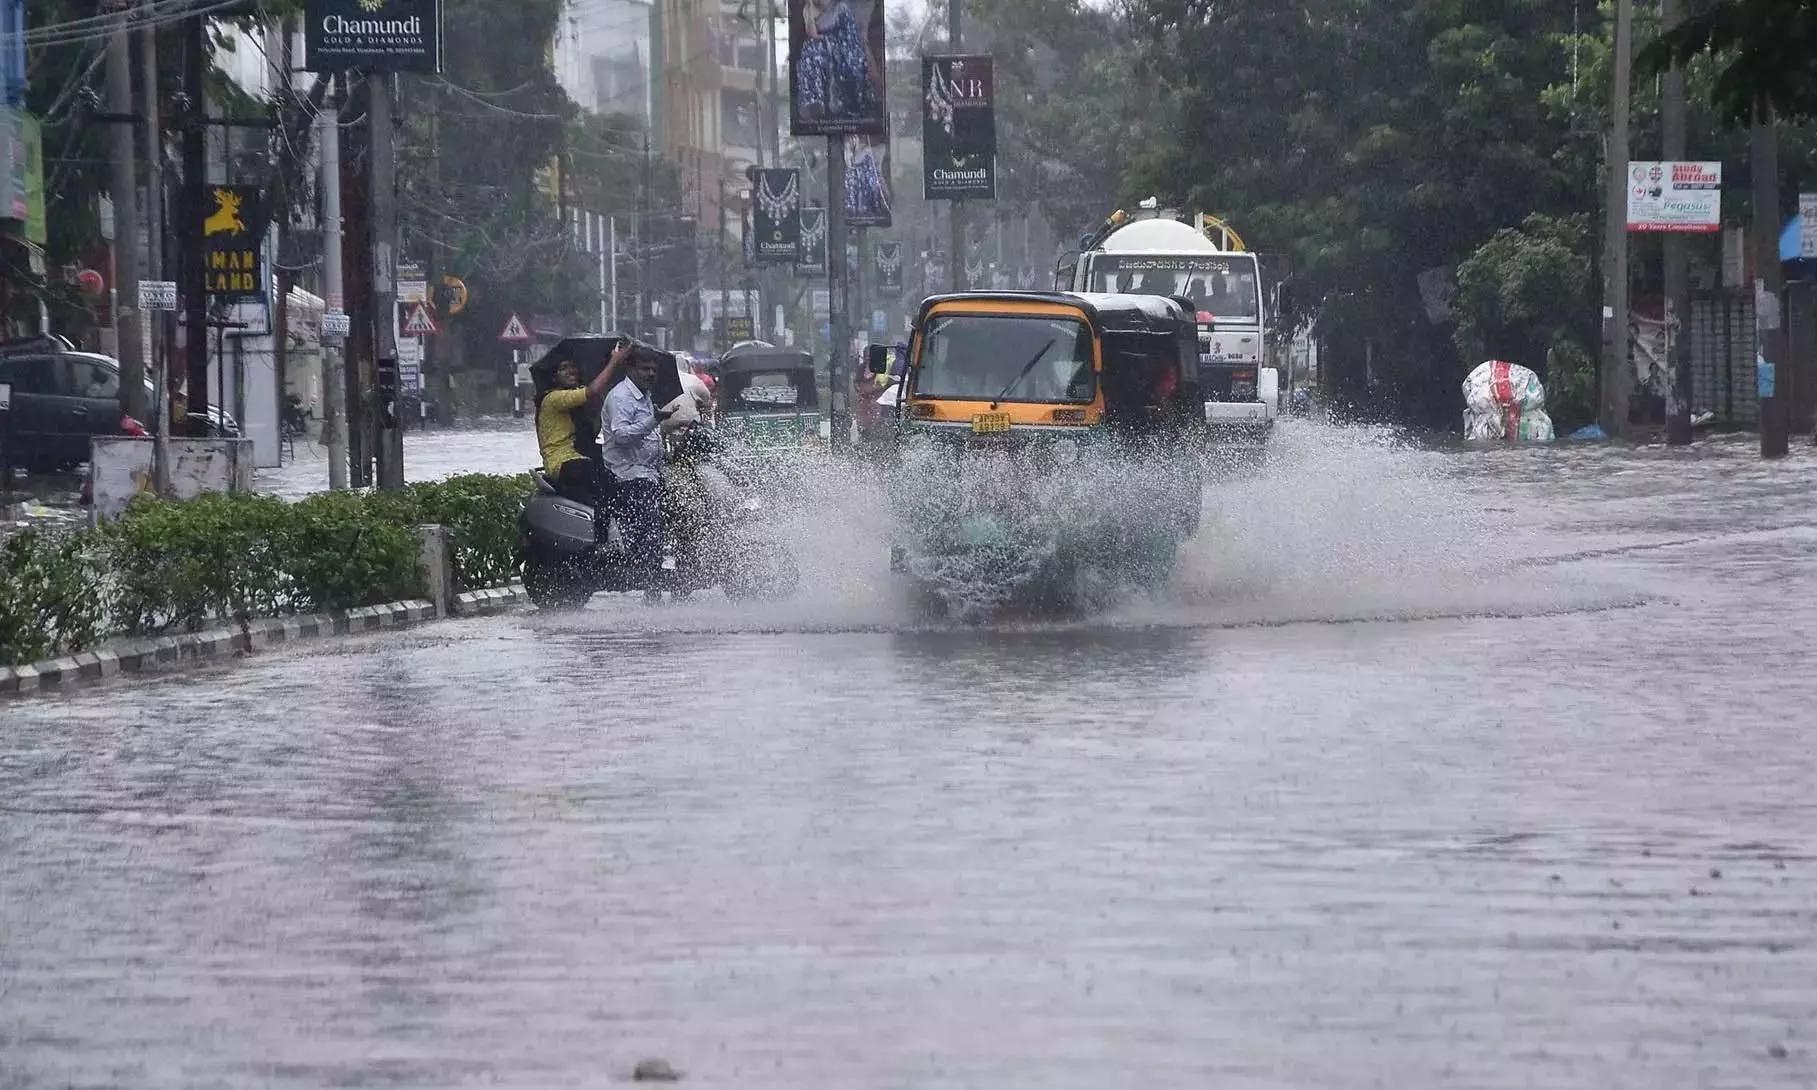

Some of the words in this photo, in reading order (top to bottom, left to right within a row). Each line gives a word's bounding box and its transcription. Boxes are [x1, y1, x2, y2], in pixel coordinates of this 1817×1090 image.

[322, 15, 421, 35] Chamundi
[323, 36, 351, 44] GOLD
[356, 36, 363, 44] &
[367, 36, 423, 44] DIAMONDS
[1672, 164, 1703, 173] Study
[933, 168, 987, 180] Chamundi
[1672, 172, 1717, 182] Abroad
